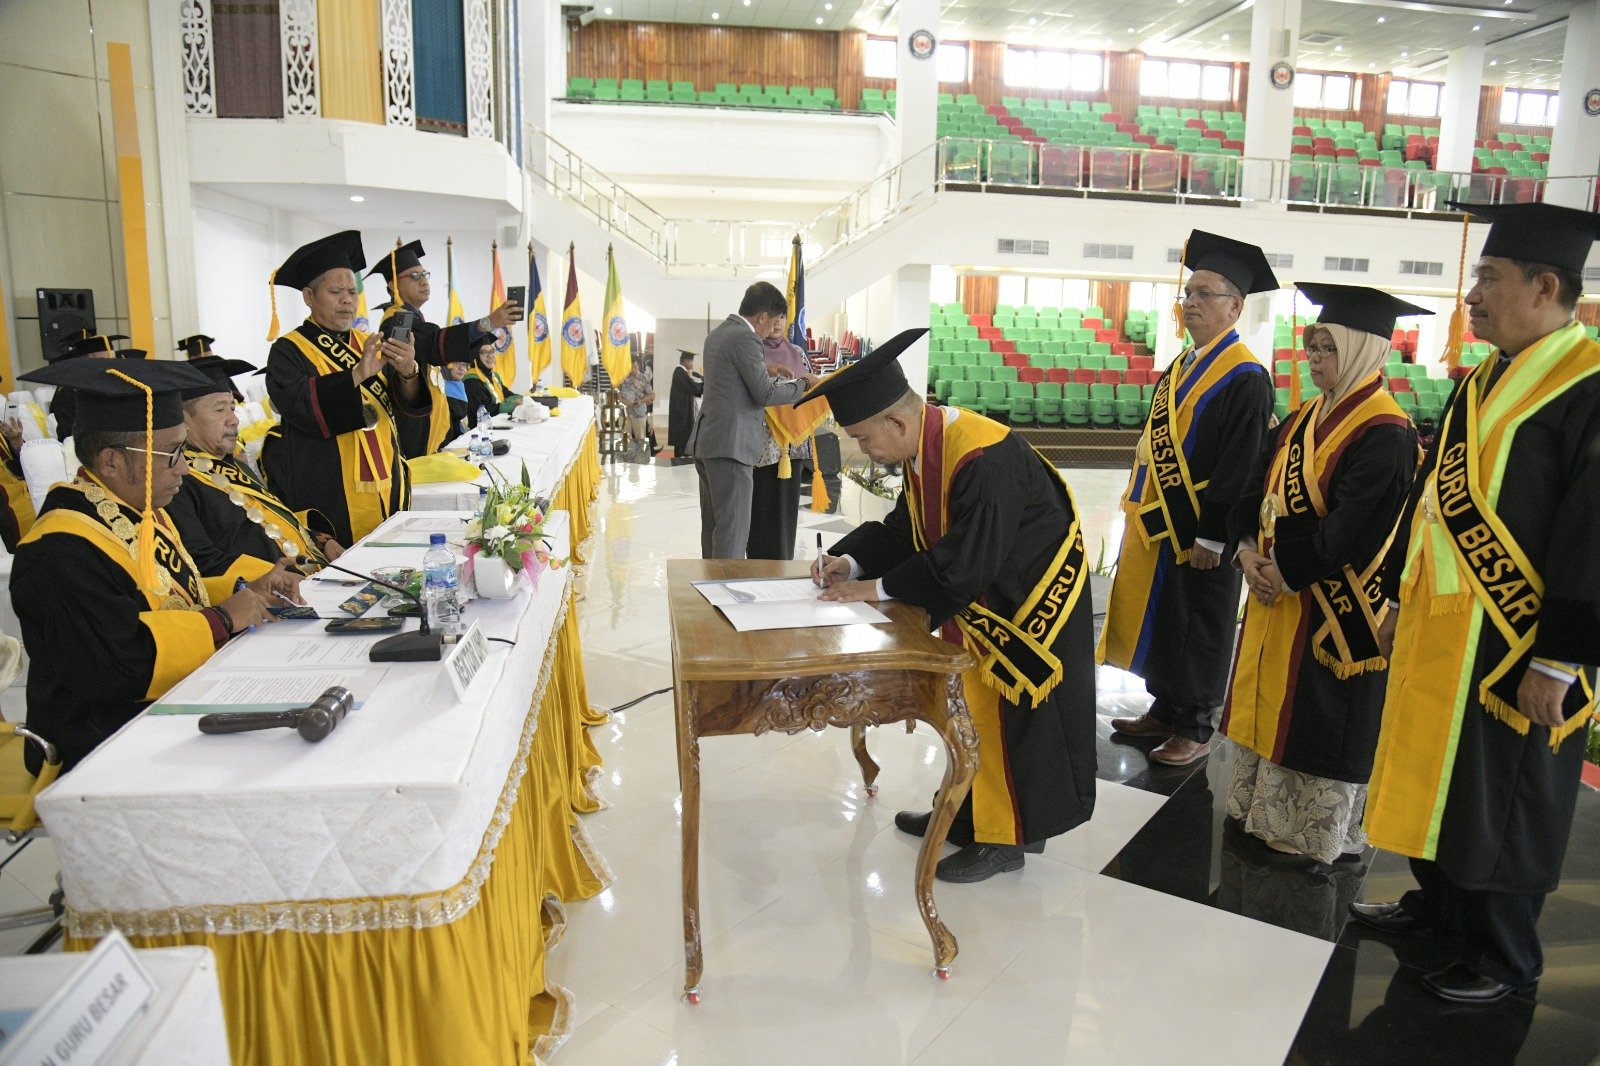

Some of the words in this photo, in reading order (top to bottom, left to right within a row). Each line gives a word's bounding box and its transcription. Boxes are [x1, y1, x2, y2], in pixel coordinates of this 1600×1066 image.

[317, 333, 356, 369] GUR
[369, 381, 395, 416] BES
[1151, 424, 1183, 490] BESAR
[1286, 443, 1308, 514] GURU
[1439, 441, 1472, 518] GURU
[1457, 522, 1542, 624] BESAR
[1027, 564, 1077, 640] GURU
[53, 1014, 94, 1062] GURU
[88, 972, 130, 1024] BESAR
